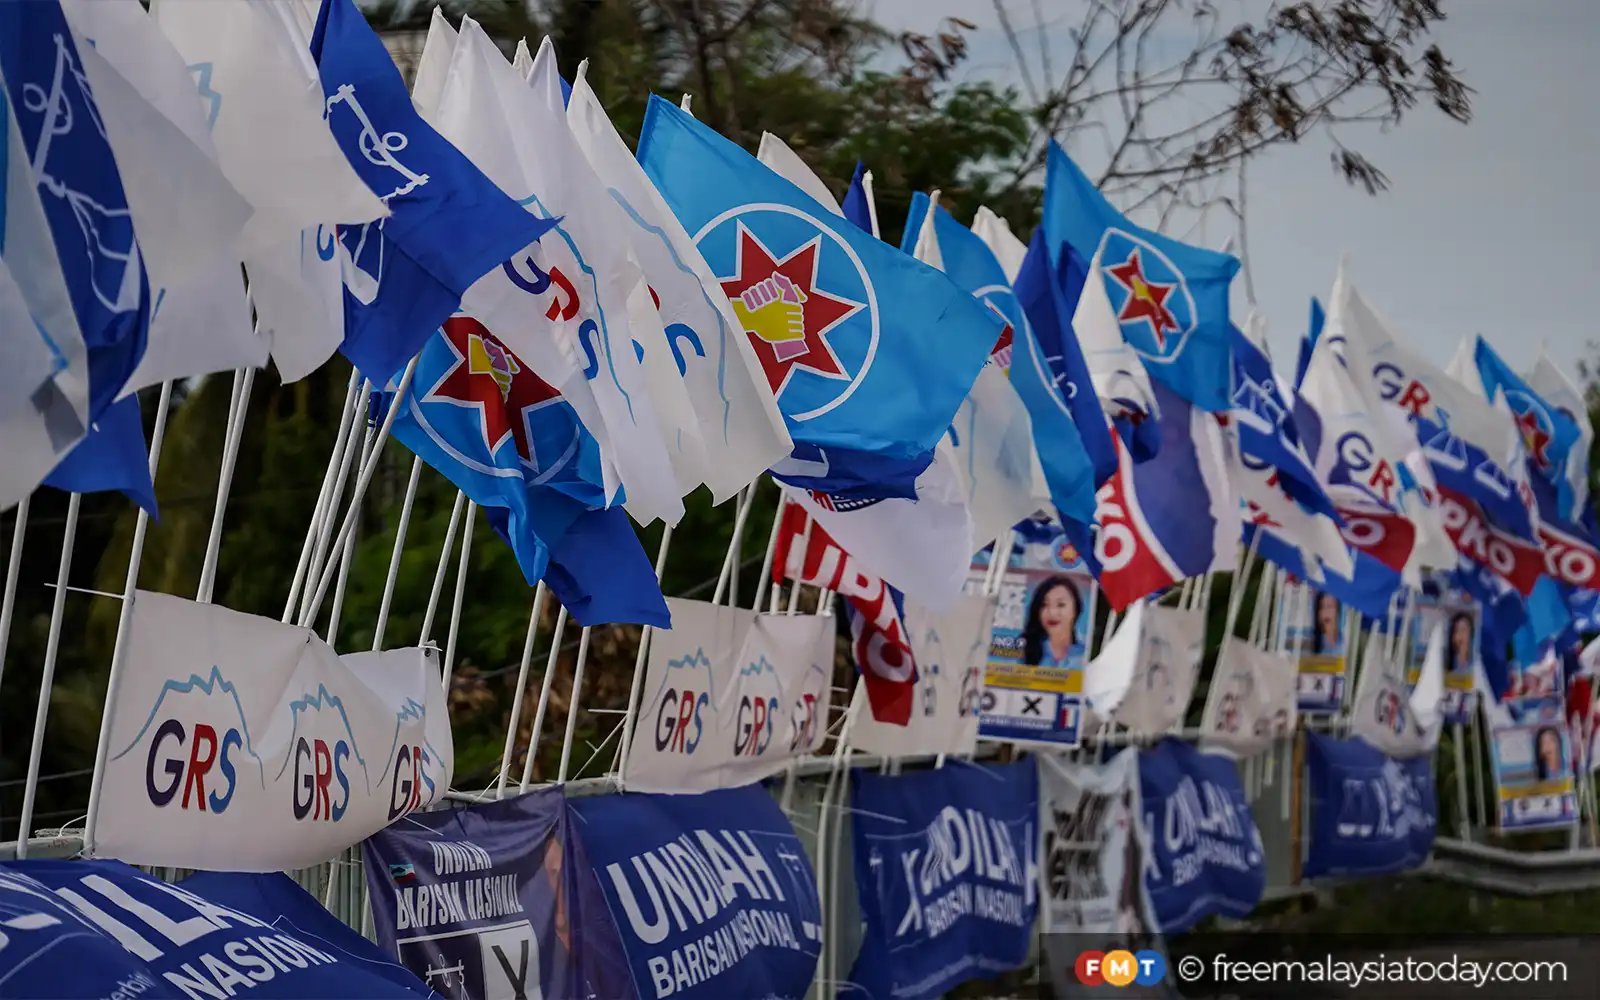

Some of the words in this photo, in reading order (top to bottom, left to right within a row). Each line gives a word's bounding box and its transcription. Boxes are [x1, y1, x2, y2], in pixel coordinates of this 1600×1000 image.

[1440, 498, 1516, 576] PKO
[655, 688, 708, 754] GRS
[733, 695, 778, 756] GRS
[146, 718, 243, 815] GRS
[292, 736, 350, 823] GRS
[388, 744, 435, 822] GRS
